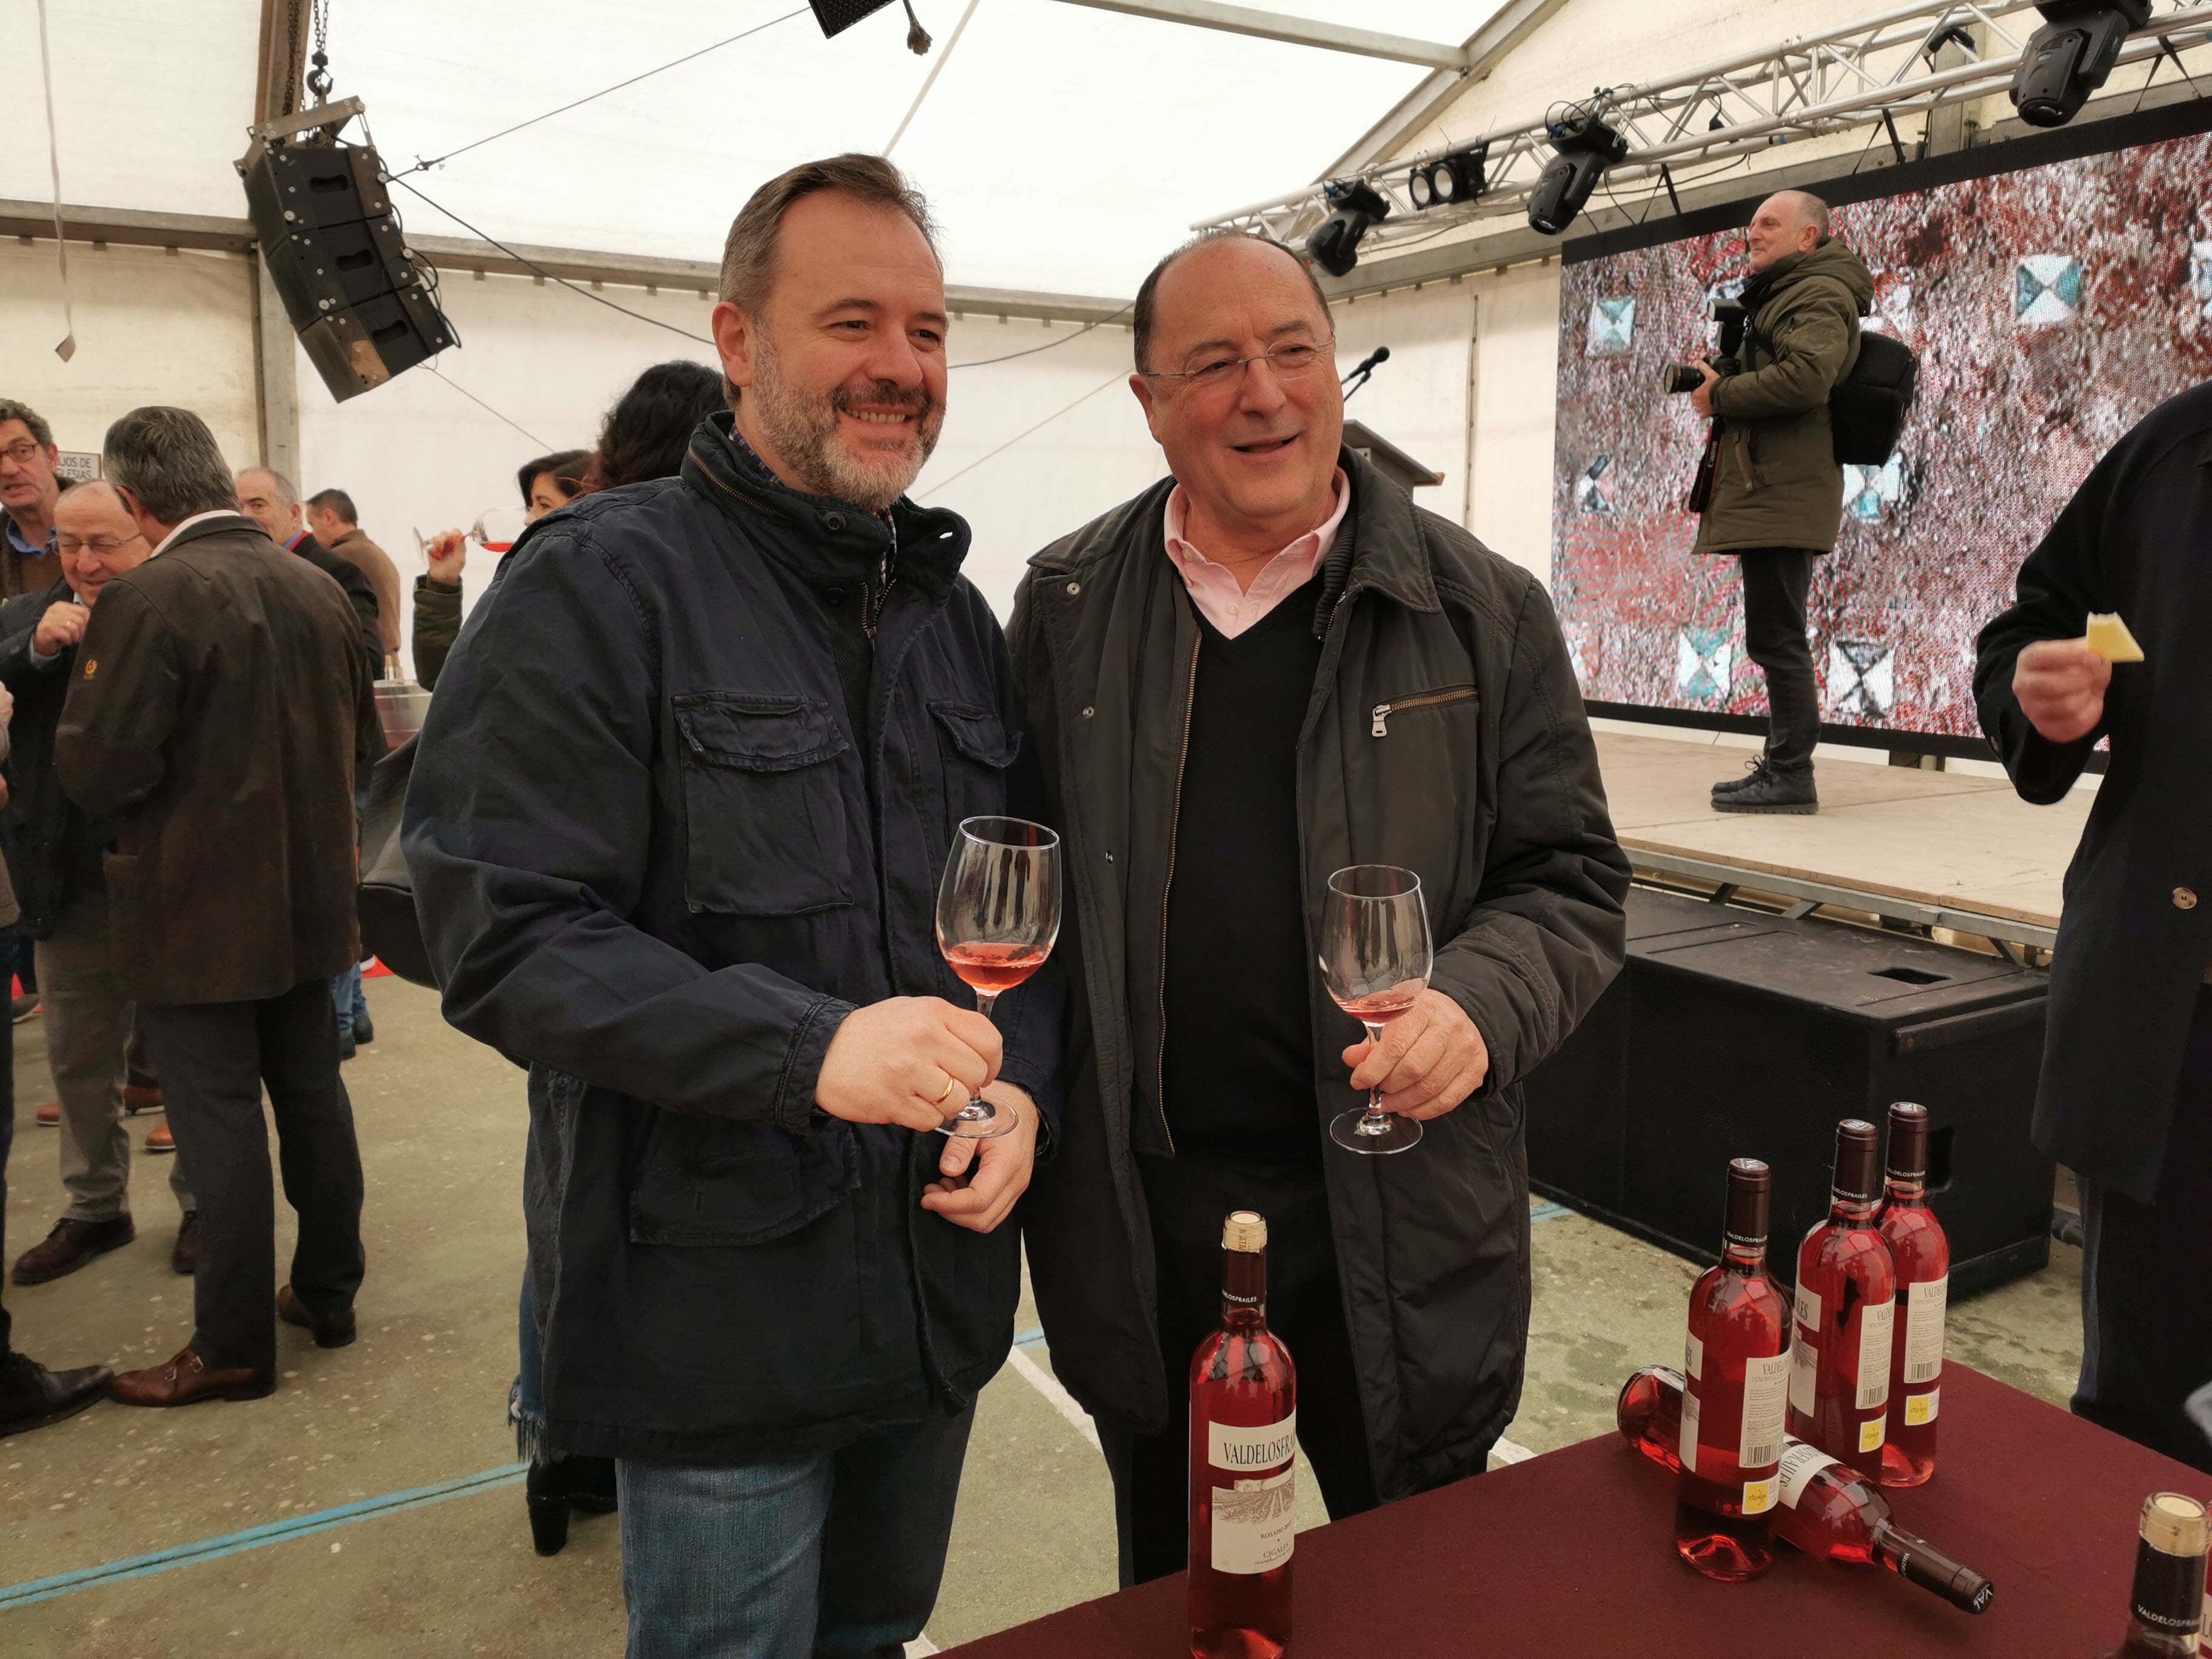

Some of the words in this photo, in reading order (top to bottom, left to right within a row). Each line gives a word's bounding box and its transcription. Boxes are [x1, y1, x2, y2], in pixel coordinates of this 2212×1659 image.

[1708, 441, 1718, 468] Canon
[58, 456, 78, 468] IJOS
[79, 457, 91, 469] DE
[57, 468, 92, 481] GLESIAS
[1261, 1526, 1284, 1540] ROSADO
